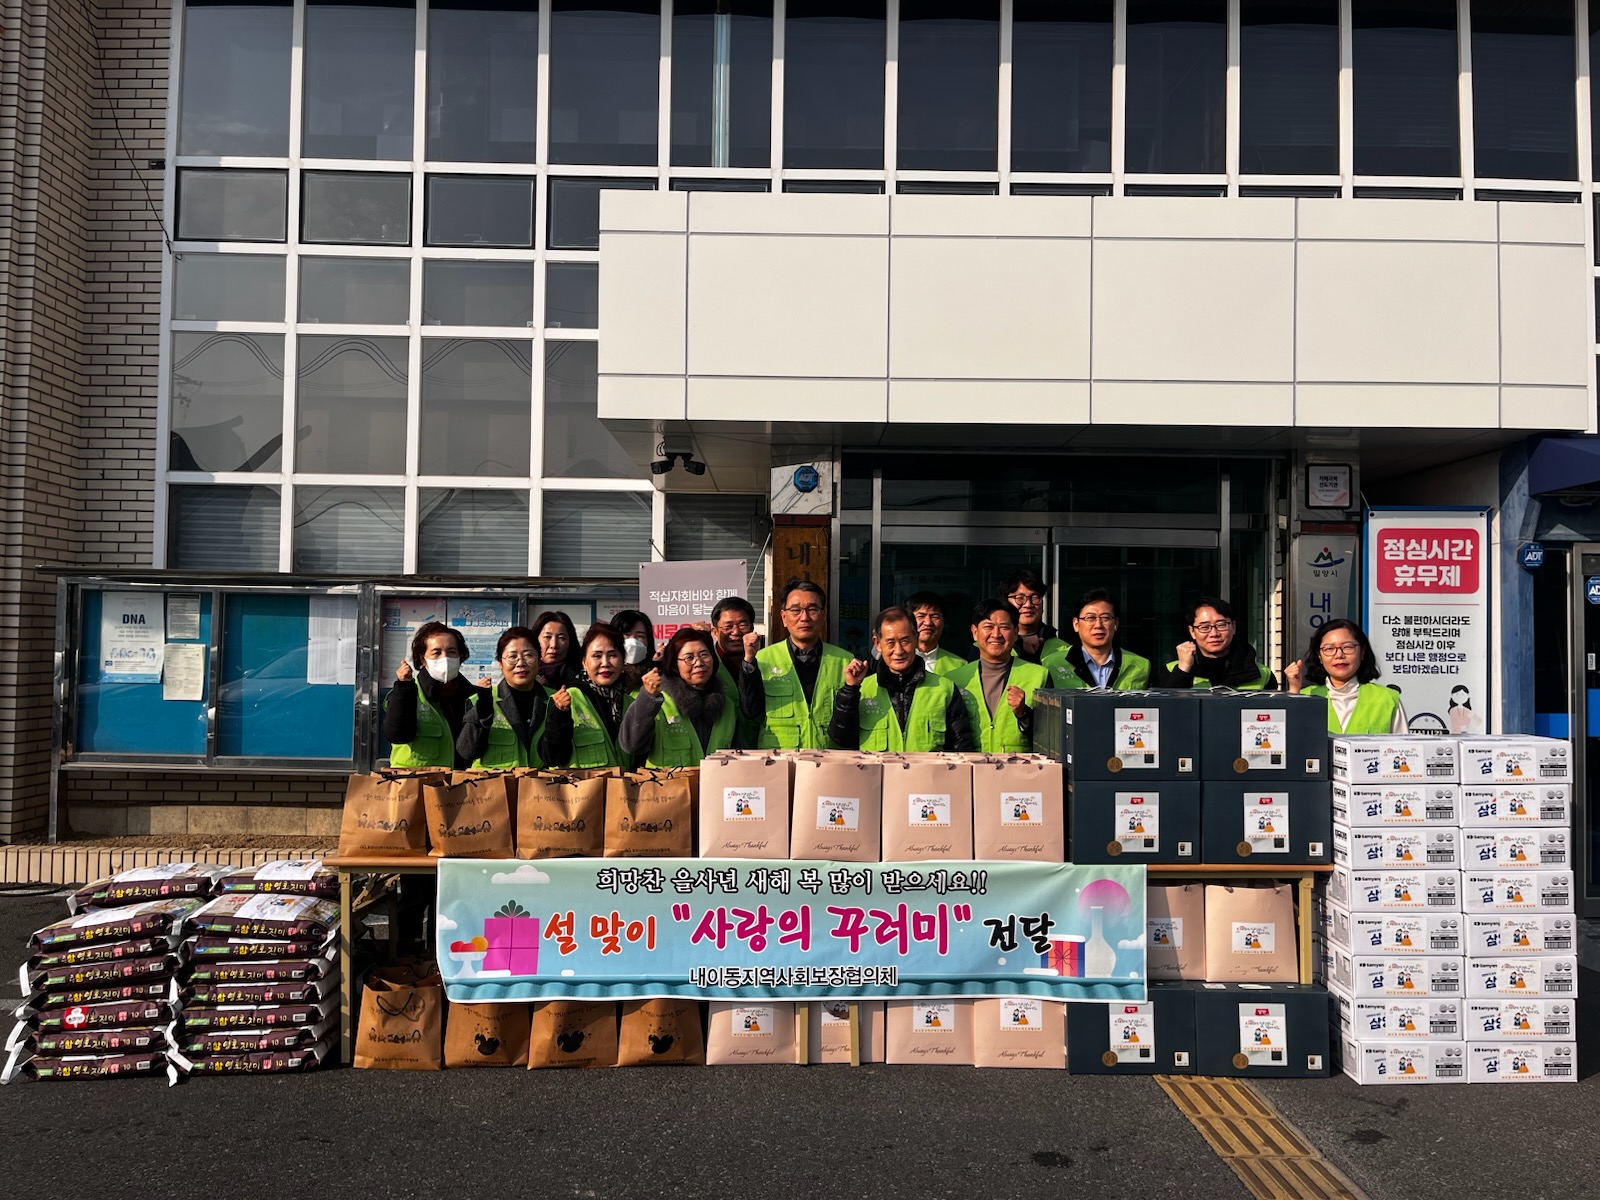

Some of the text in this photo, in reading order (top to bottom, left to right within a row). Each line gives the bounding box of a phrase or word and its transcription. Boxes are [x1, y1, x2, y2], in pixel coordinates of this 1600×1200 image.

[1383, 538, 1474, 561] 점심시간
[1524, 551, 1541, 560] ADT
[1312, 570, 1338, 578] 밀양시
[1394, 564, 1460, 587] 휴무제
[649, 588, 738, 602] 적십자회비와 함께
[1588, 585, 1600, 595] AD
[657, 605, 690, 616] 마음이
[122, 614, 146, 624] DNA
[1382, 616, 1471, 626] 다소 불편하시더라도
[1391, 628, 1460, 638] 양해 부탁드리며
[1396, 640, 1456, 650] 점심시간 이후
[1386, 652, 1466, 662] 보다 나은 행정으로
[1392, 664, 1460, 675] 보답하겠습니다
[741, 840, 768, 850] Thankful
[832, 844, 860, 852] Thankful
[924, 844, 952, 853] Thankful
[1017, 844, 1044, 854] Thankful
[597, 868, 988, 895] 희망찬 을사년 새해 복 많이 받으세요!!
[544, 911, 578, 956] 설
[590, 911, 657, 956] 맞이
[983, 912, 1055, 956] 전달
[688, 966, 898, 988] 내이동지역사회보장협의체
[748, 1048, 776, 1056] Thankful
[928, 1046, 956, 1055] Thankful
[1018, 1050, 1046, 1059] Thankful
